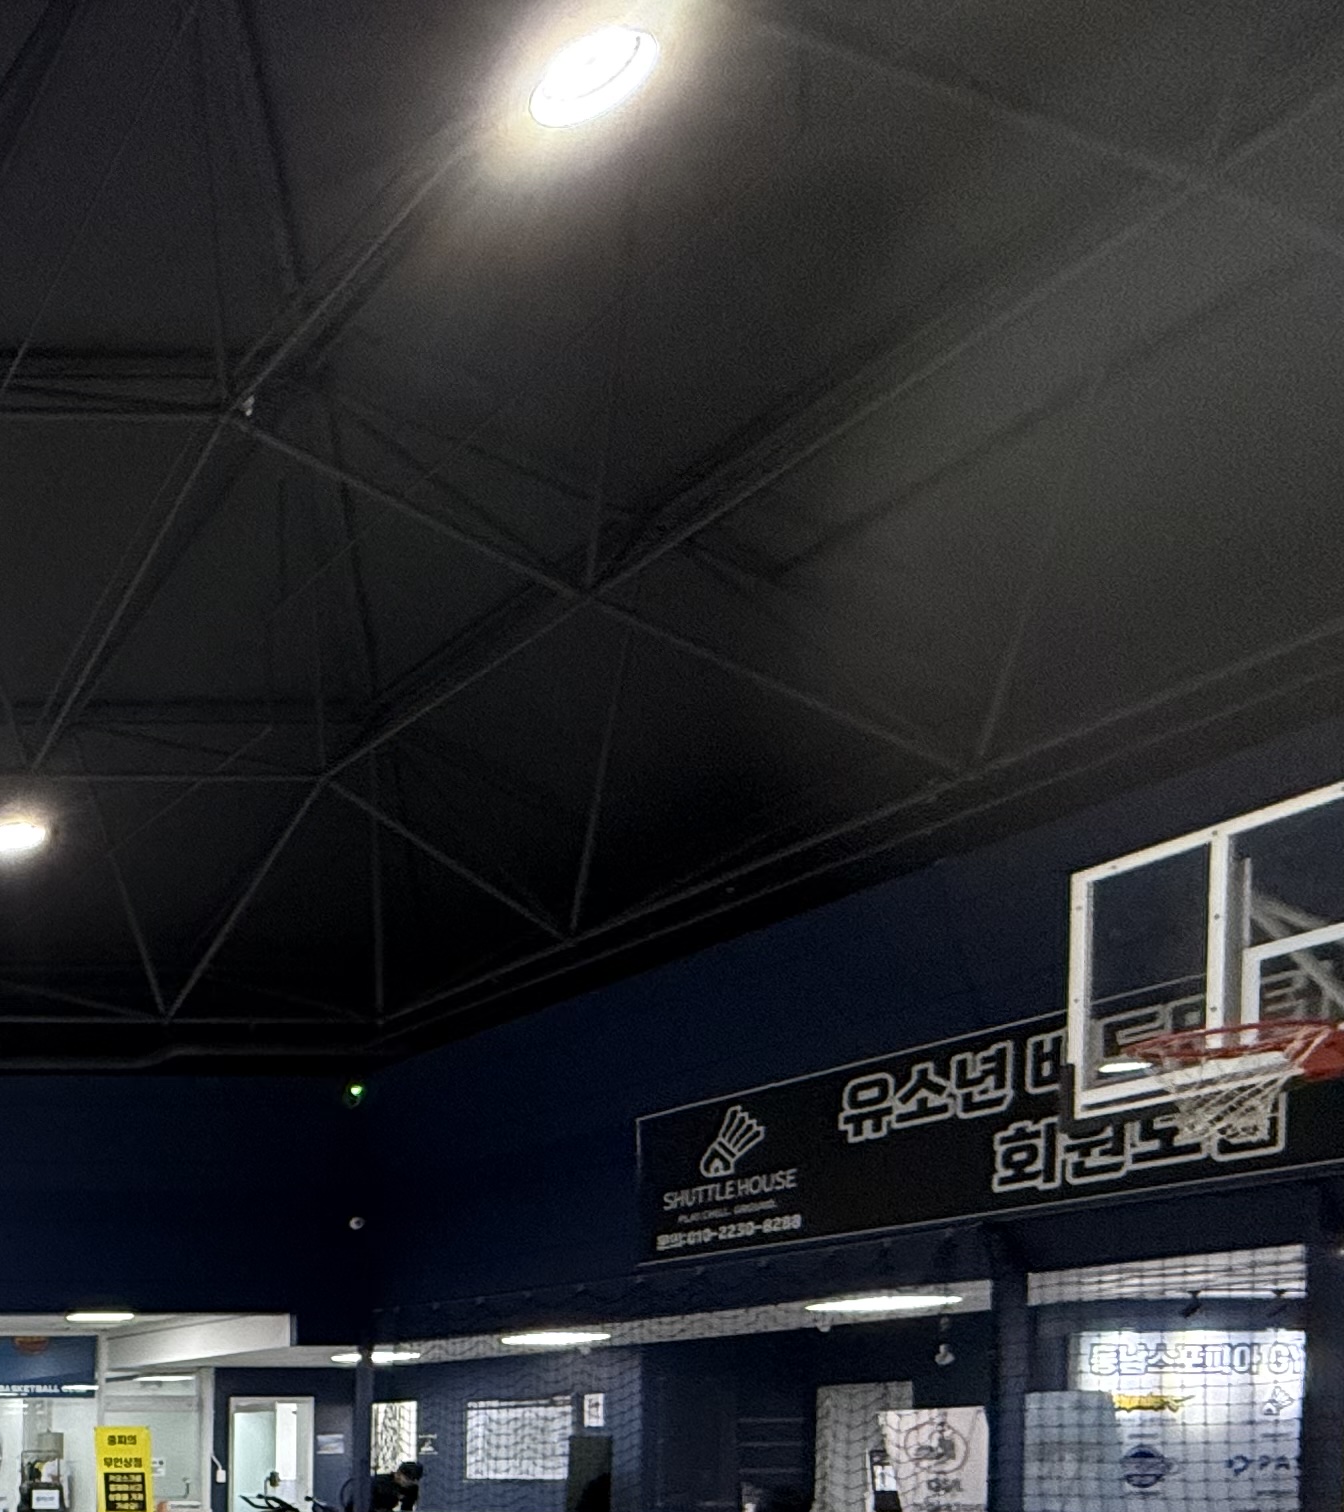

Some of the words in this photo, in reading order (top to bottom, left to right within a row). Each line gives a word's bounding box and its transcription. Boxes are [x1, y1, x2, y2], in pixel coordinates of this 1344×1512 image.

[838, 1039, 1014, 1143] 유소년
[663, 1180, 735, 1211] SHUTTLE
[737, 1168, 798, 1197] HOUSE
[1090, 1342, 1261, 1375] 동남스포피아
[103, 1457, 143, 1468] 무인상점
